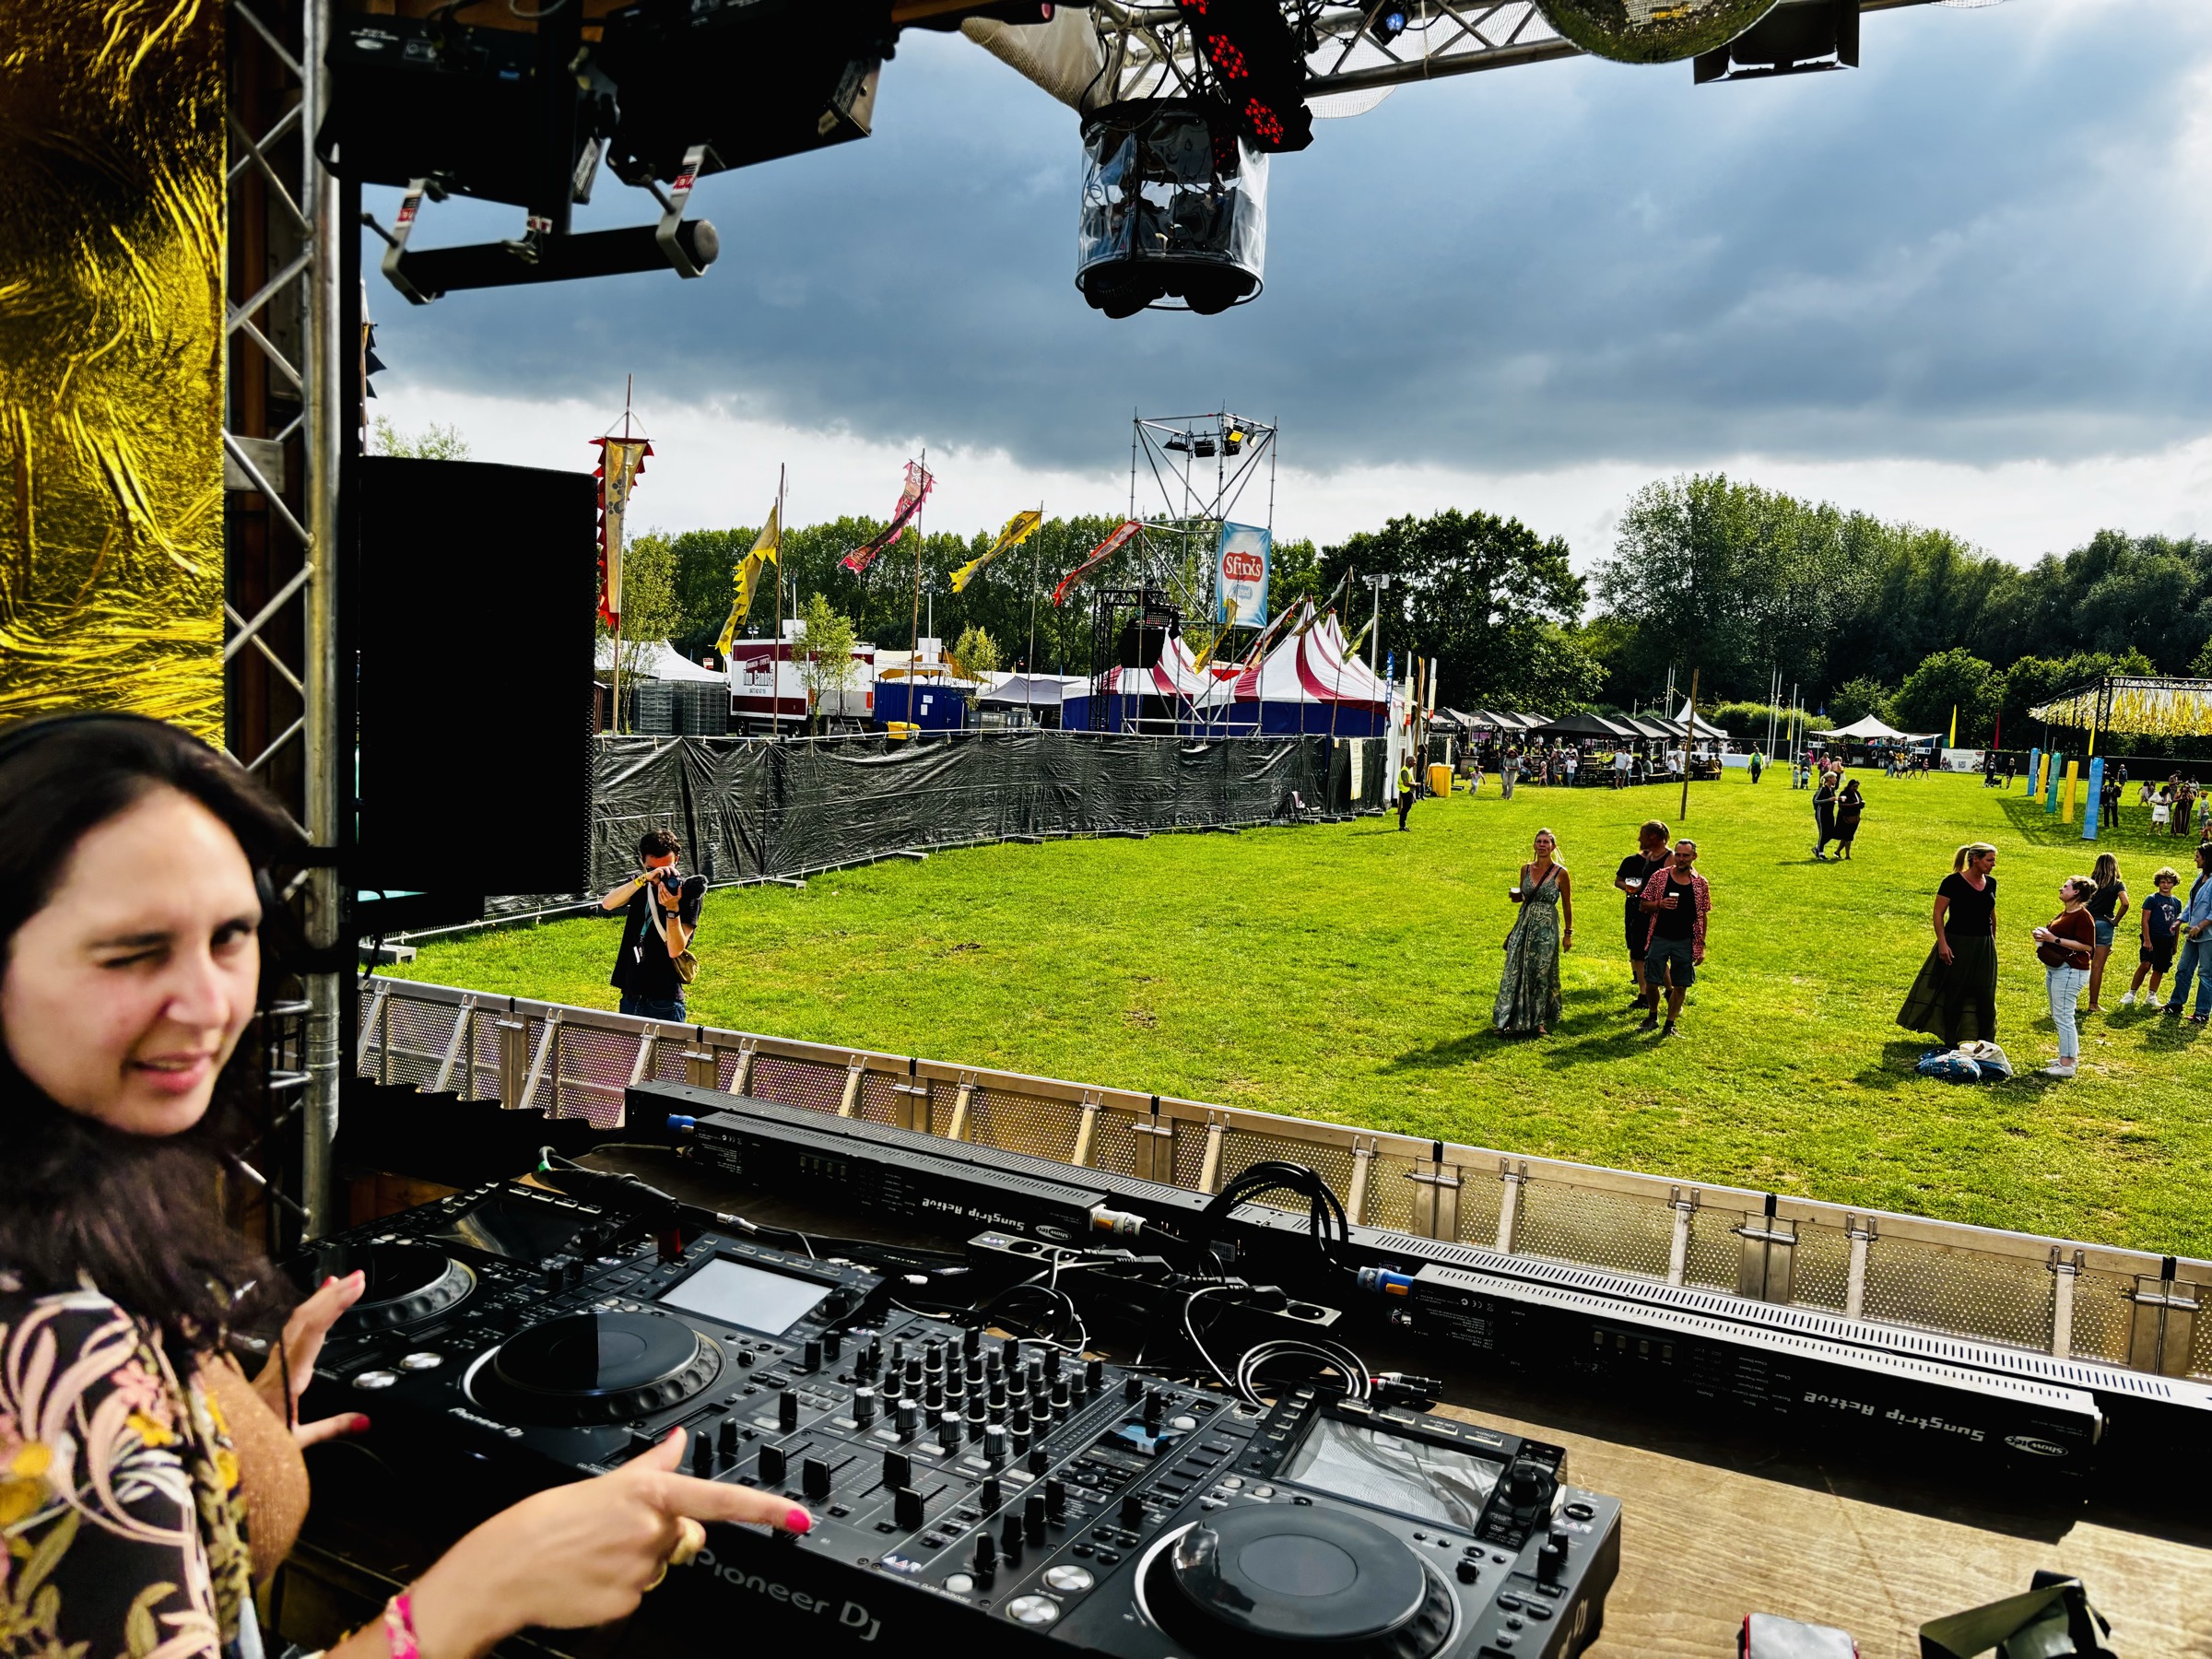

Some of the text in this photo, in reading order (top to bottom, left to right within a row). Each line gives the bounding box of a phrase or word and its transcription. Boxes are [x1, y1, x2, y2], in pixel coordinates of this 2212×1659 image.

[1226, 556, 1262, 577] Sfinks
[448, 1407, 506, 1430] Pioneer
[688, 1546, 830, 1614] Pioneer
